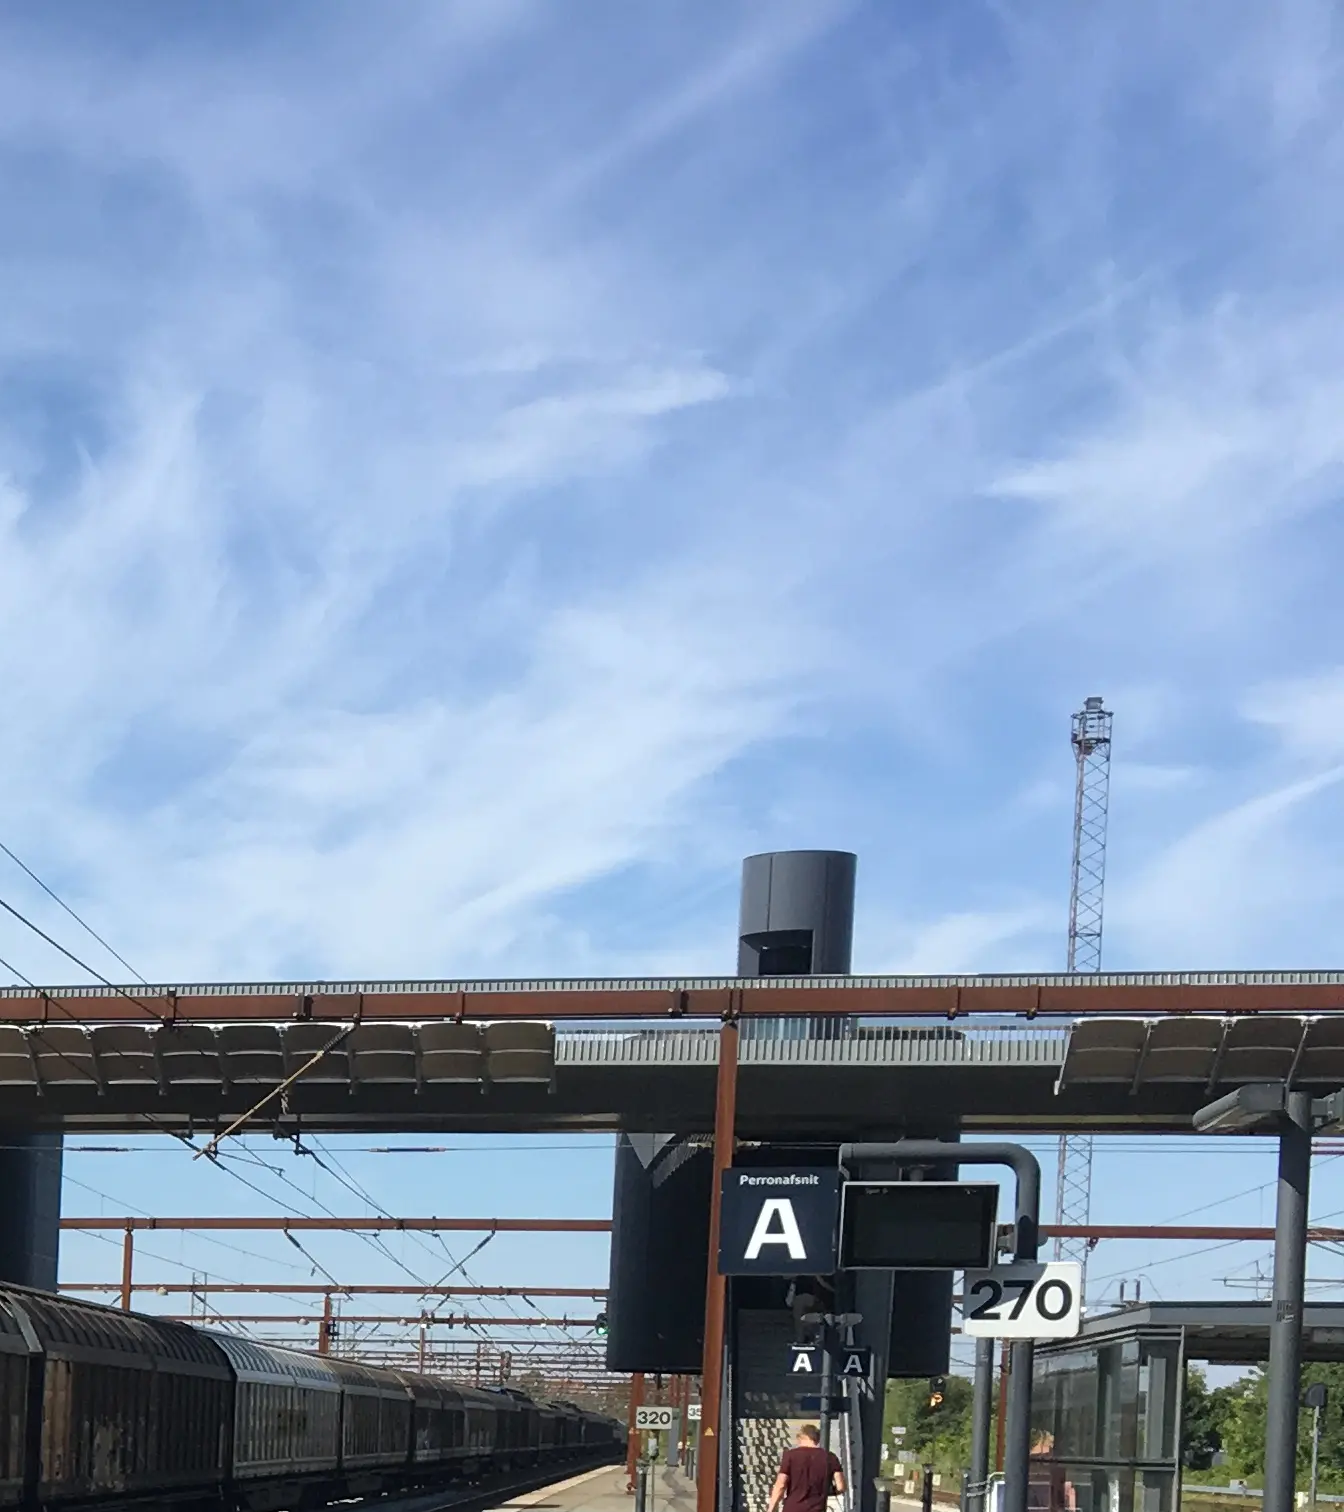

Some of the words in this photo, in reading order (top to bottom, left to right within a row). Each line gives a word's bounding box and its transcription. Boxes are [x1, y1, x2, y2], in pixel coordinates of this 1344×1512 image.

[739, 1174, 819, 1186] Perronafsnit
[744, 1198, 807, 1260] A
[970, 1279, 1072, 1321] 270
[793, 1353, 812, 1372] A
[843, 1354, 863, 1373] A
[637, 1411, 671, 1425] 320
[688, 1407, 702, 1417] 35
